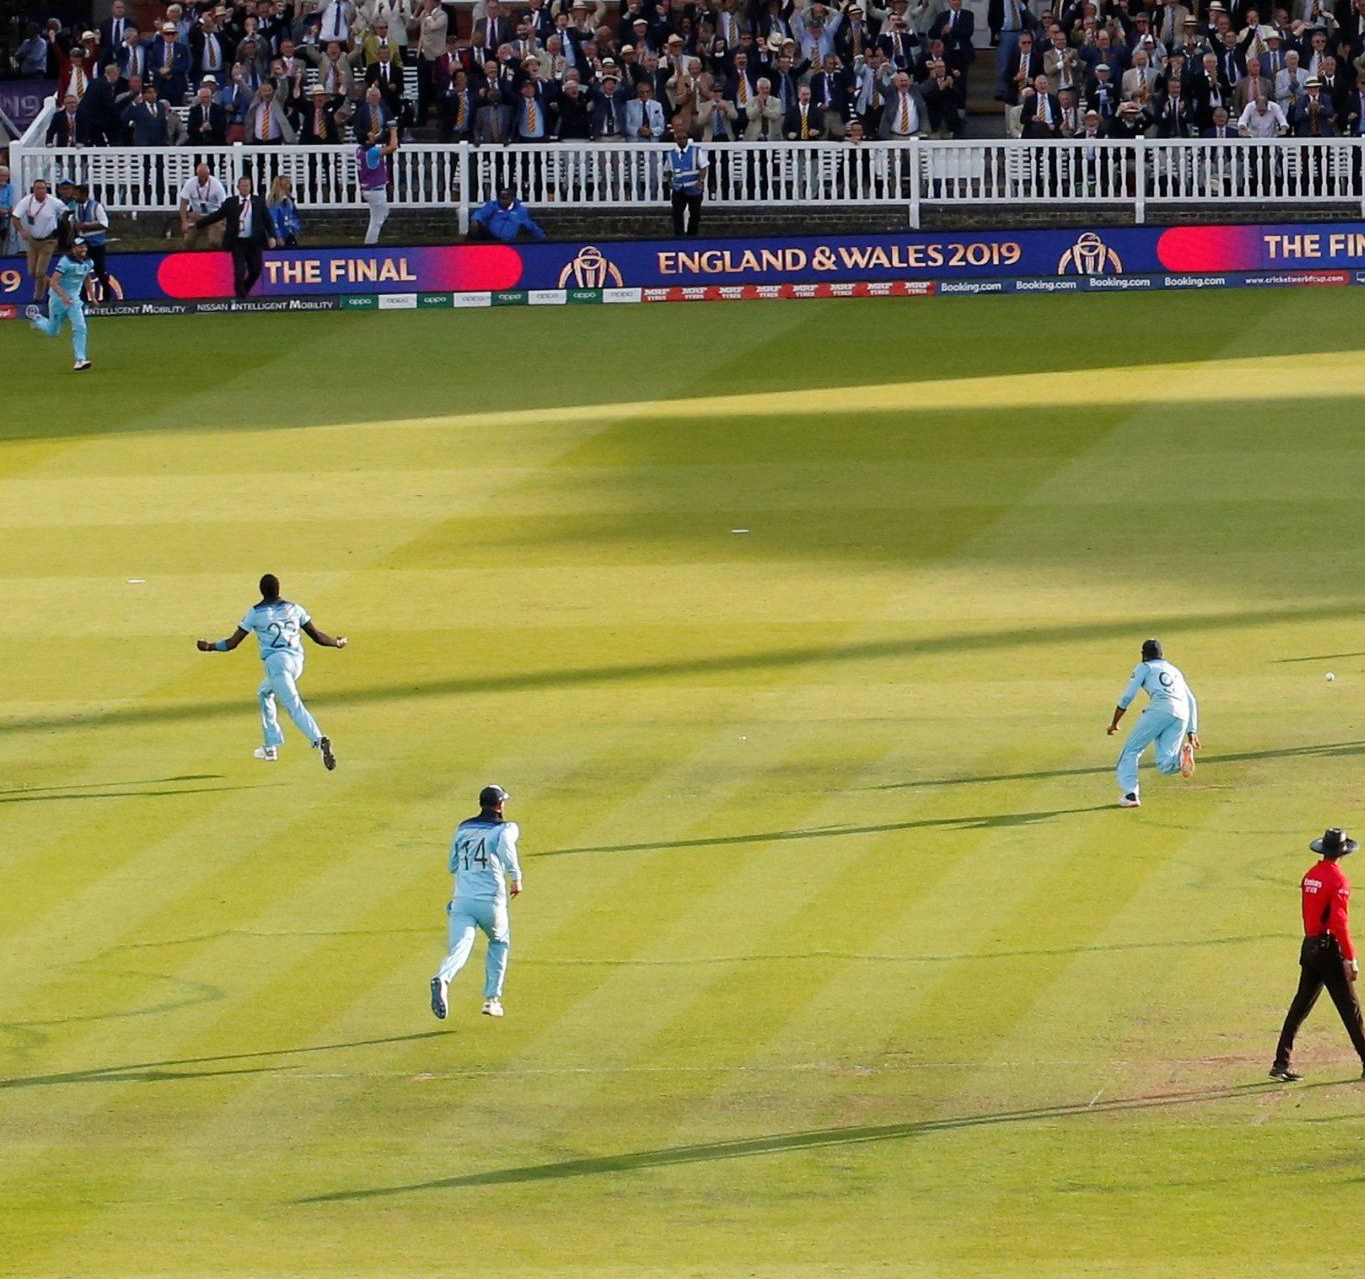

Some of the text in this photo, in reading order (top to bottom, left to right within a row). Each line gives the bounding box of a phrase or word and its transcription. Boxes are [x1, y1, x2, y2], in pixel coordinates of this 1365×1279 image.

[1264, 234, 1321, 258] THE
[657, 249, 807, 274] ENGLAND
[837, 244, 945, 269] WALES
[948, 242, 1022, 266] 2019
[264, 258, 417, 284] THE FINAL
[941, 281, 1001, 293] Booking.com
[1016, 279, 1077, 291] Booking.com
[1090, 277, 1150, 289] Booking.com
[1165, 275, 1225, 288] Booking.com
[460, 837, 488, 871] 14
